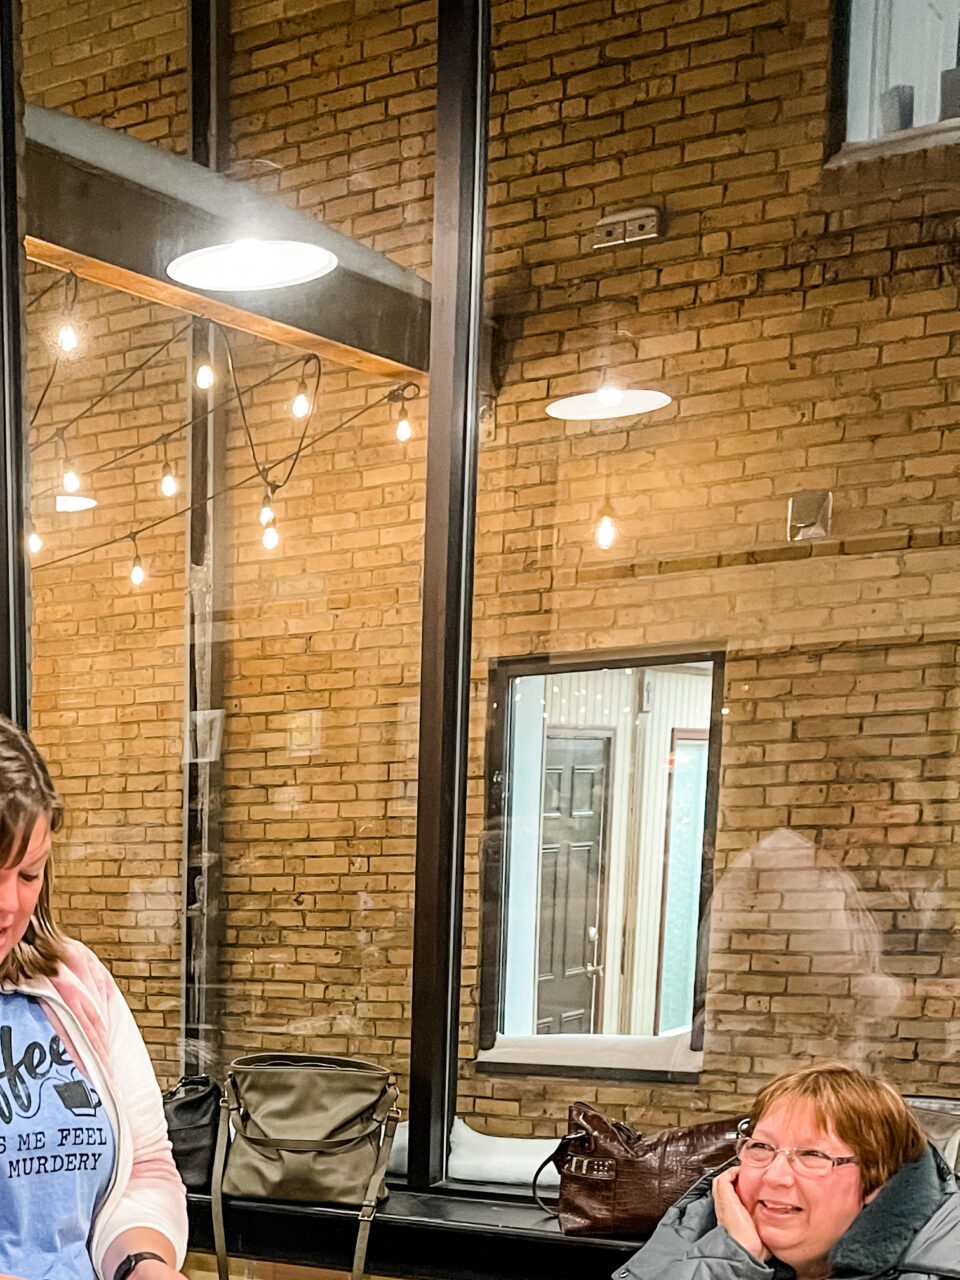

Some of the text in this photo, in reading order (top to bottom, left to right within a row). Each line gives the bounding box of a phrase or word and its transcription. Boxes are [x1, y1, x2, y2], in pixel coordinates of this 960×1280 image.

[17, 1131, 46, 1151] ME
[58, 1127, 108, 1146] FEEL
[8, 1152, 102, 1179] MURDERY
